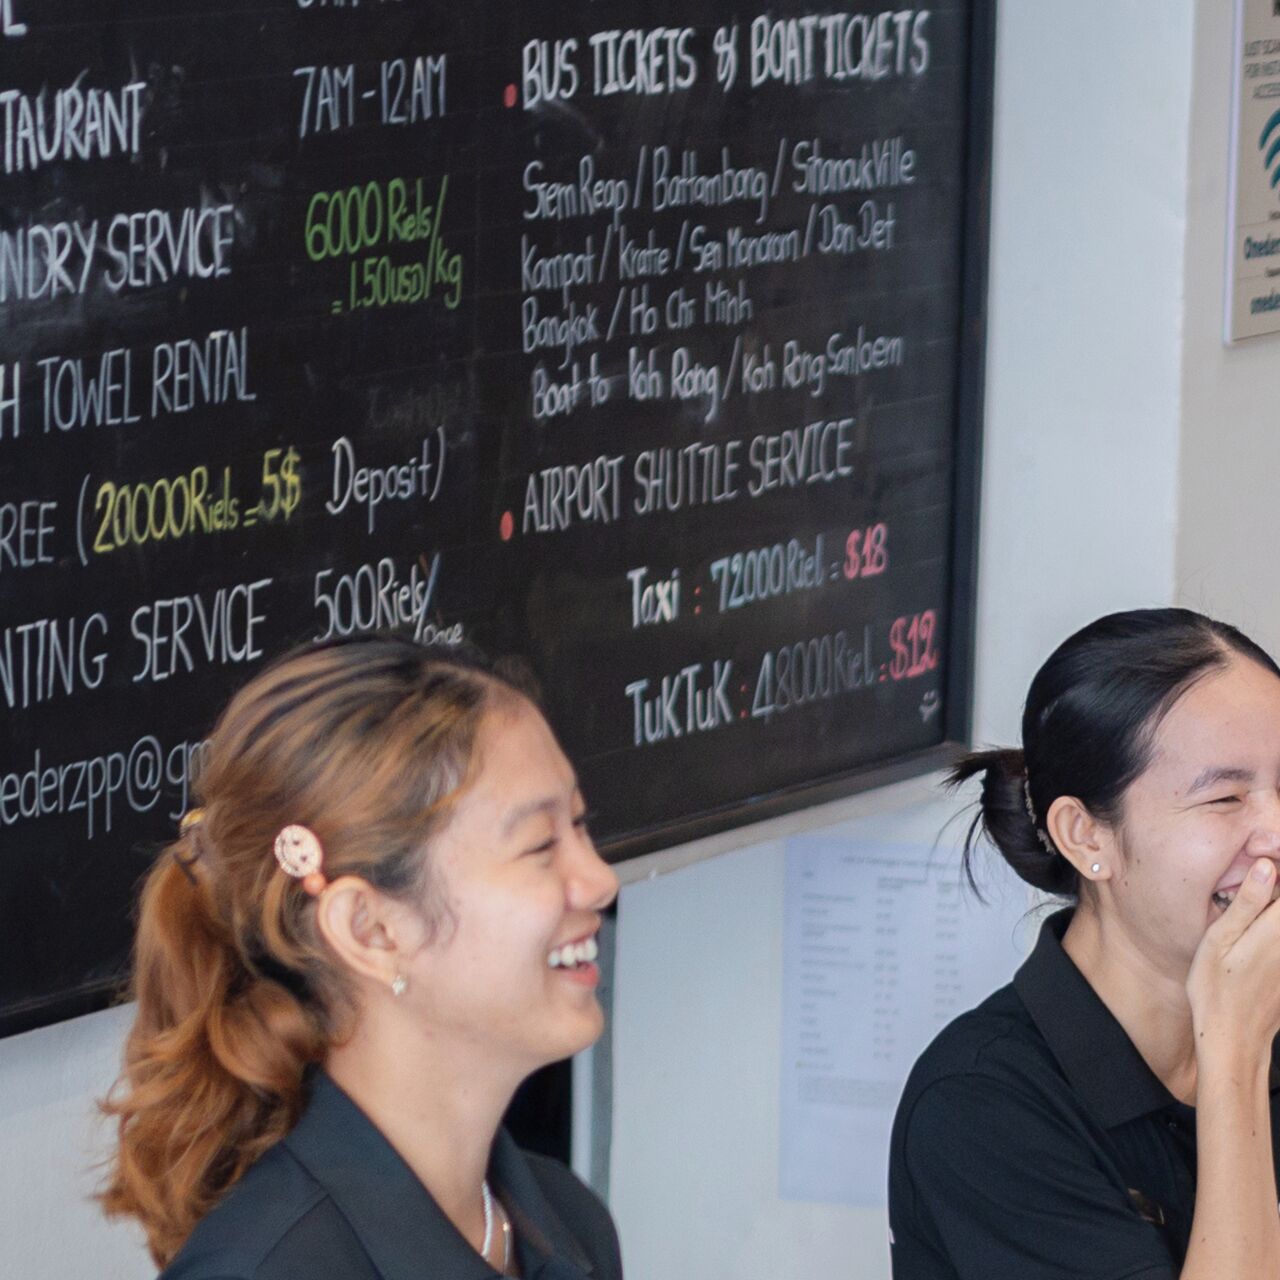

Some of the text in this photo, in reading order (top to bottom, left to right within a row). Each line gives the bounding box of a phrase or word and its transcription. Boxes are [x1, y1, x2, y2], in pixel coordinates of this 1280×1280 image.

[523, 38, 579, 110] BUS
[588, 27, 698, 96] TICKETS
[104, 204, 234, 291] SERVICE
[305, 191, 383, 262] 6000
[522, 296, 599, 370] Bangkok
[630, 283, 658, 336] Ho
[37, 348, 141, 433] TOWEL
[151, 326, 257, 419] RENTAL
[532, 366, 582, 420] Boat
[587, 352, 611, 407] to
[523, 418, 855, 534] AIRPORT SHUTTLE SERVICE
[131, 578, 273, 682] SERVICE
[626, 567, 681, 629] Taxi
